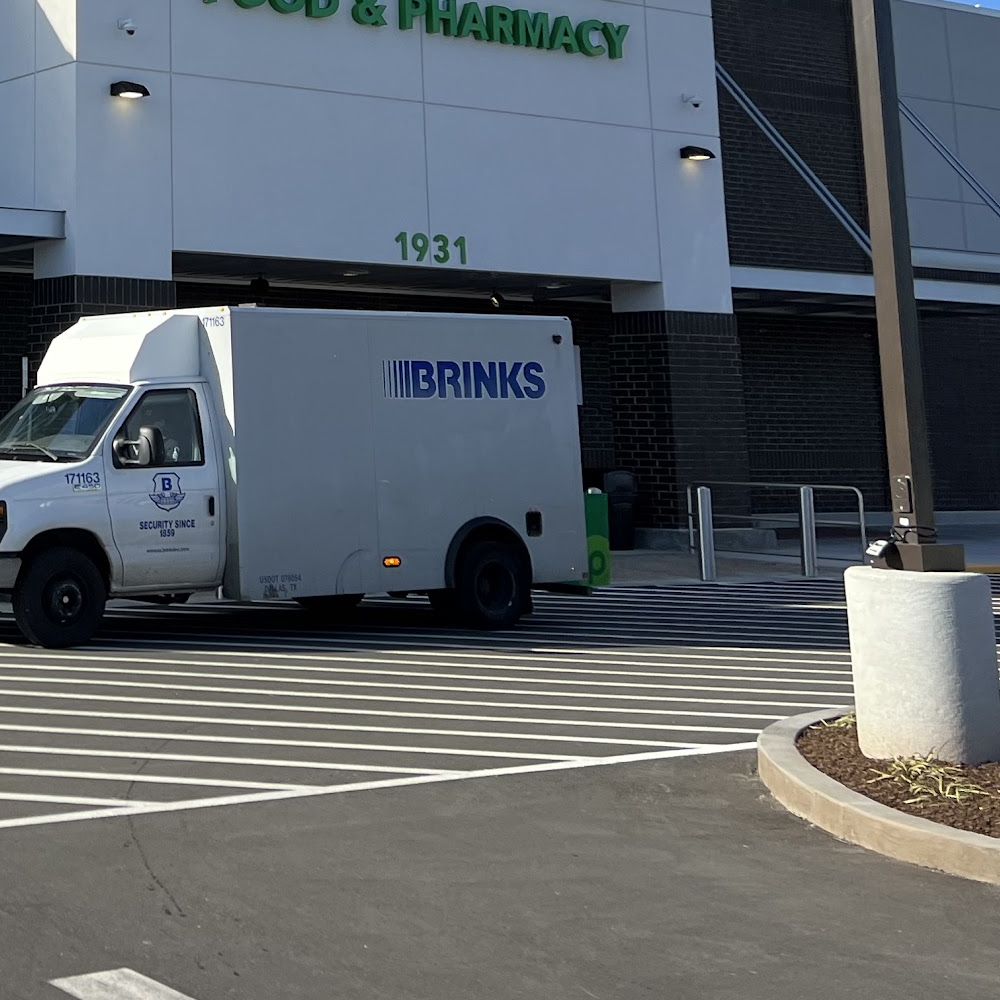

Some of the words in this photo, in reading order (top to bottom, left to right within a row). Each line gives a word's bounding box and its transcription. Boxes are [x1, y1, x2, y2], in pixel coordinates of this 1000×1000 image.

[395, 231, 467, 265] 1931
[410, 360, 546, 399] BRINKS
[64, 472, 100, 484] 171163
[161, 477, 172, 491] B
[139, 520, 173, 530] SECURITY
[174, 519, 196, 528] SINCE
[159, 528, 176, 537] 1859
